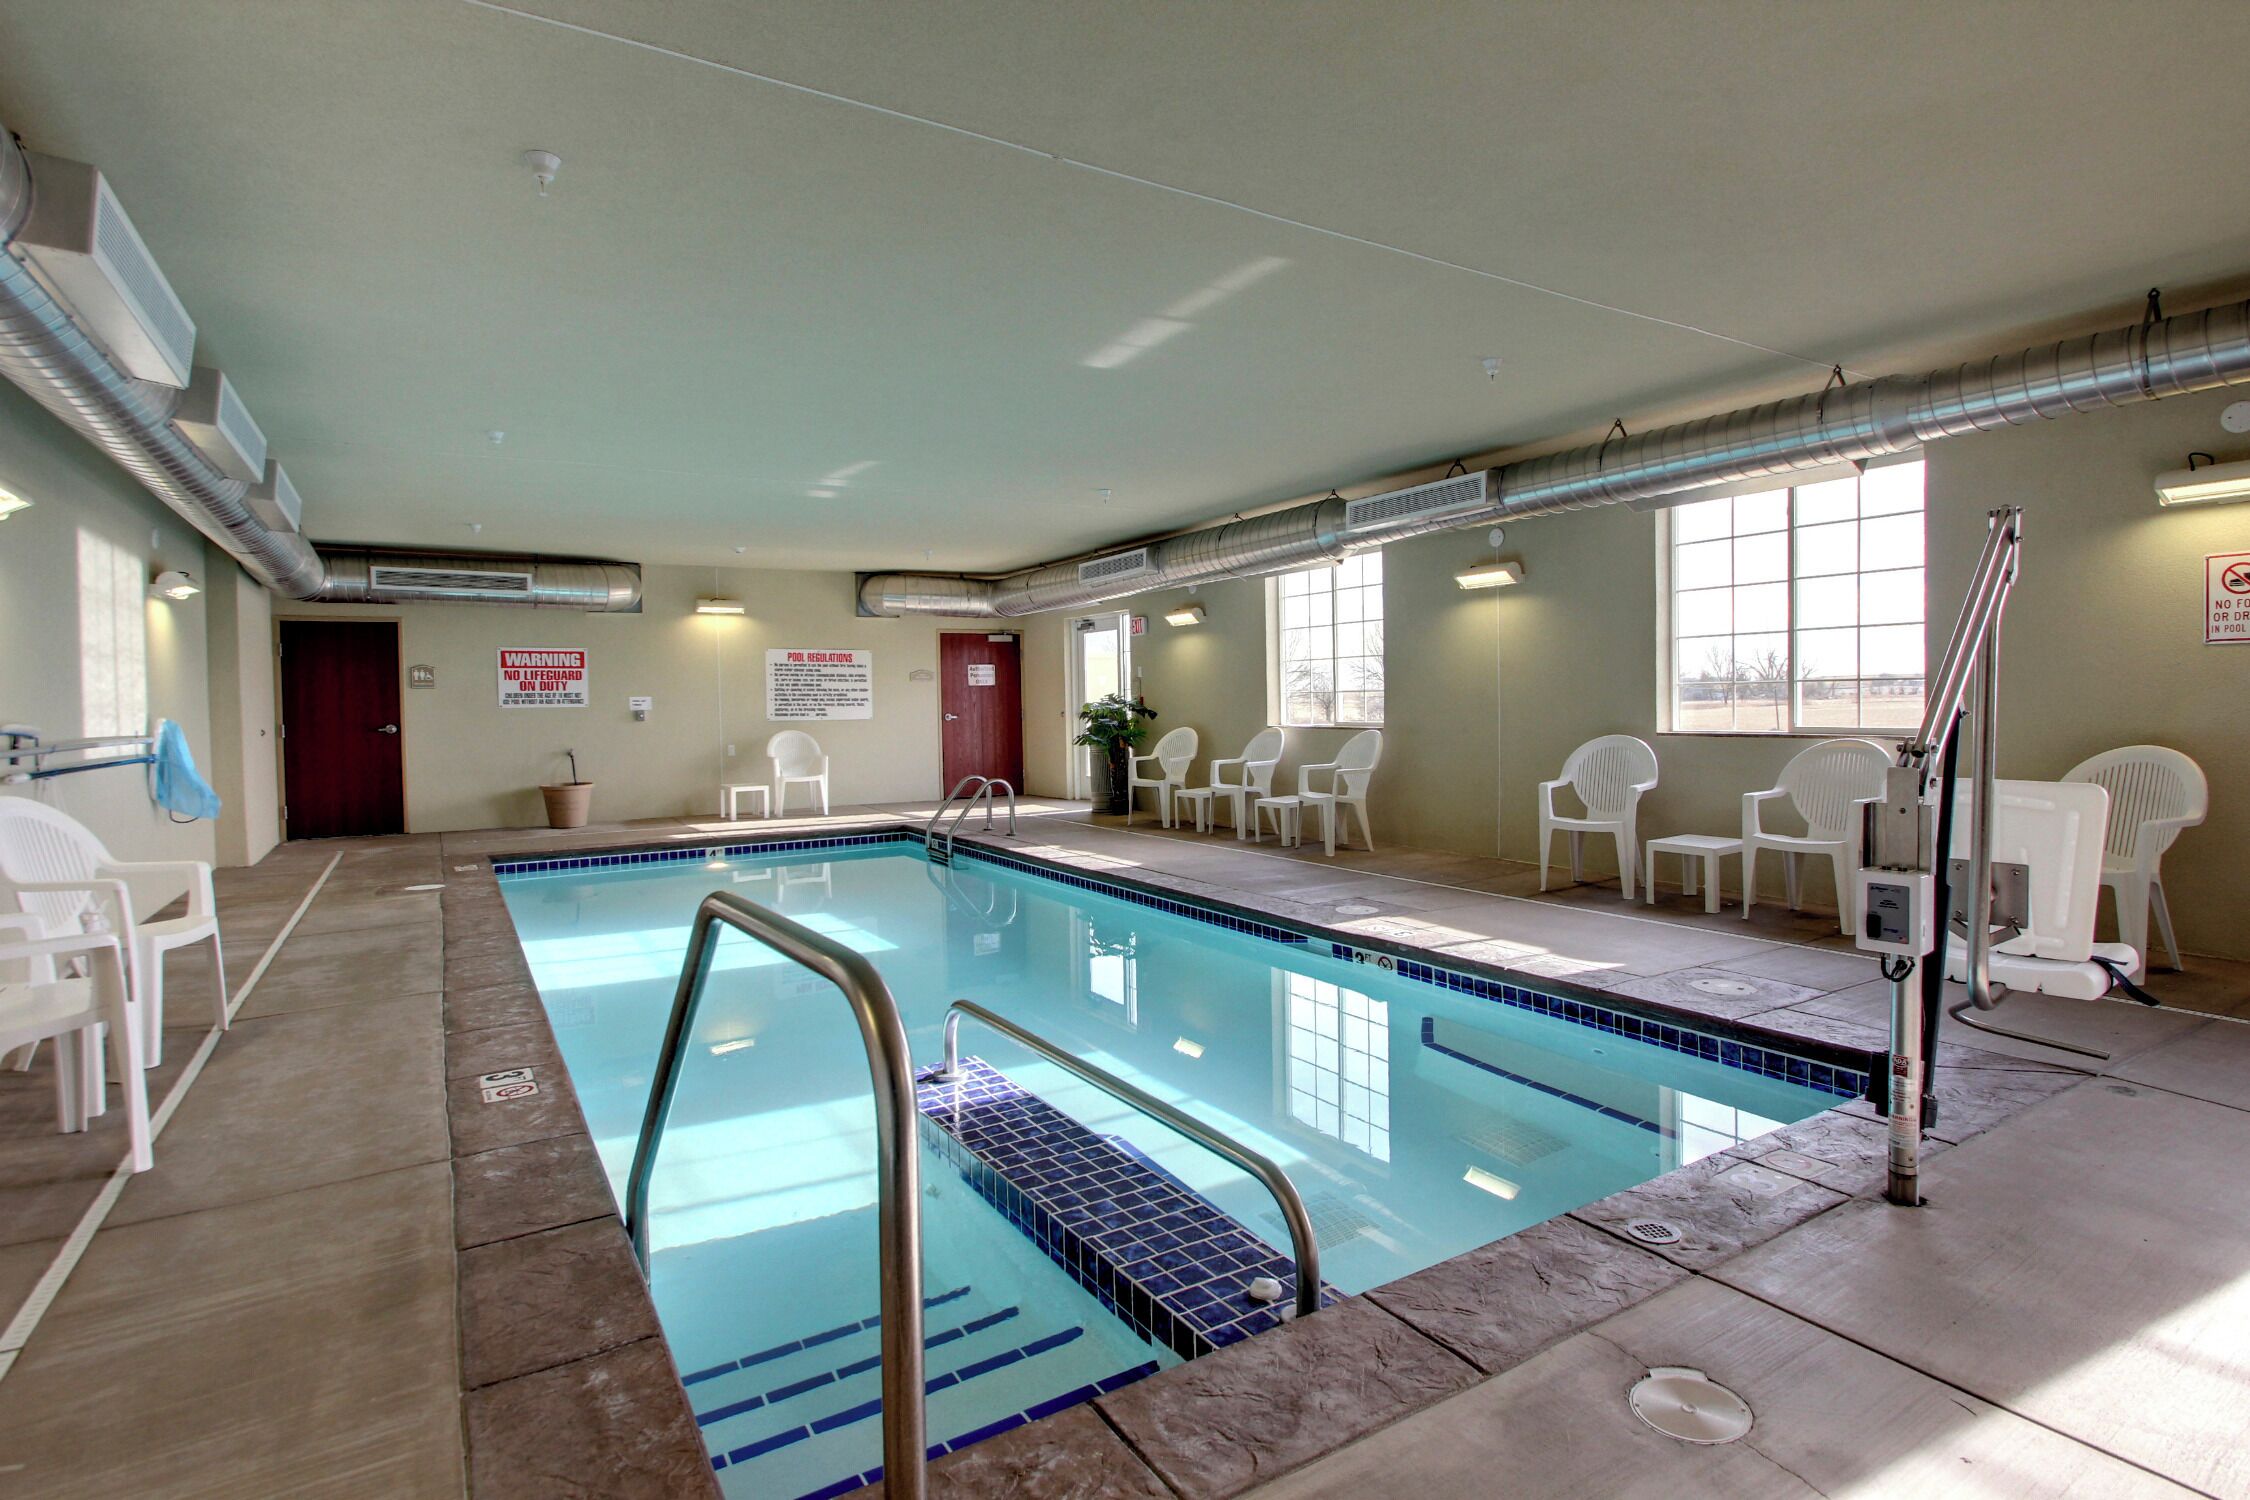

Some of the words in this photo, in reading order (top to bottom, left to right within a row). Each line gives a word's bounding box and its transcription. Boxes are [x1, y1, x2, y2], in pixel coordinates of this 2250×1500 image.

[2215, 600, 2231, 609] NO
[2213, 612, 2229, 622] OR
[1131, 619, 1143, 634] EXIT
[2211, 625, 2220, 633] IN
[2224, 624, 2246, 632] POOL
[504, 652, 581, 667] WARNING
[787, 652, 805, 662] POOL
[807, 653, 853, 663] REGULATIONS
[504, 670, 520, 681] NO
[524, 670, 582, 681] LIFEGUARD
[519, 681, 535, 691] ON
[539, 681, 568, 691] DUTY
[486, 1071, 524, 1081] 3
